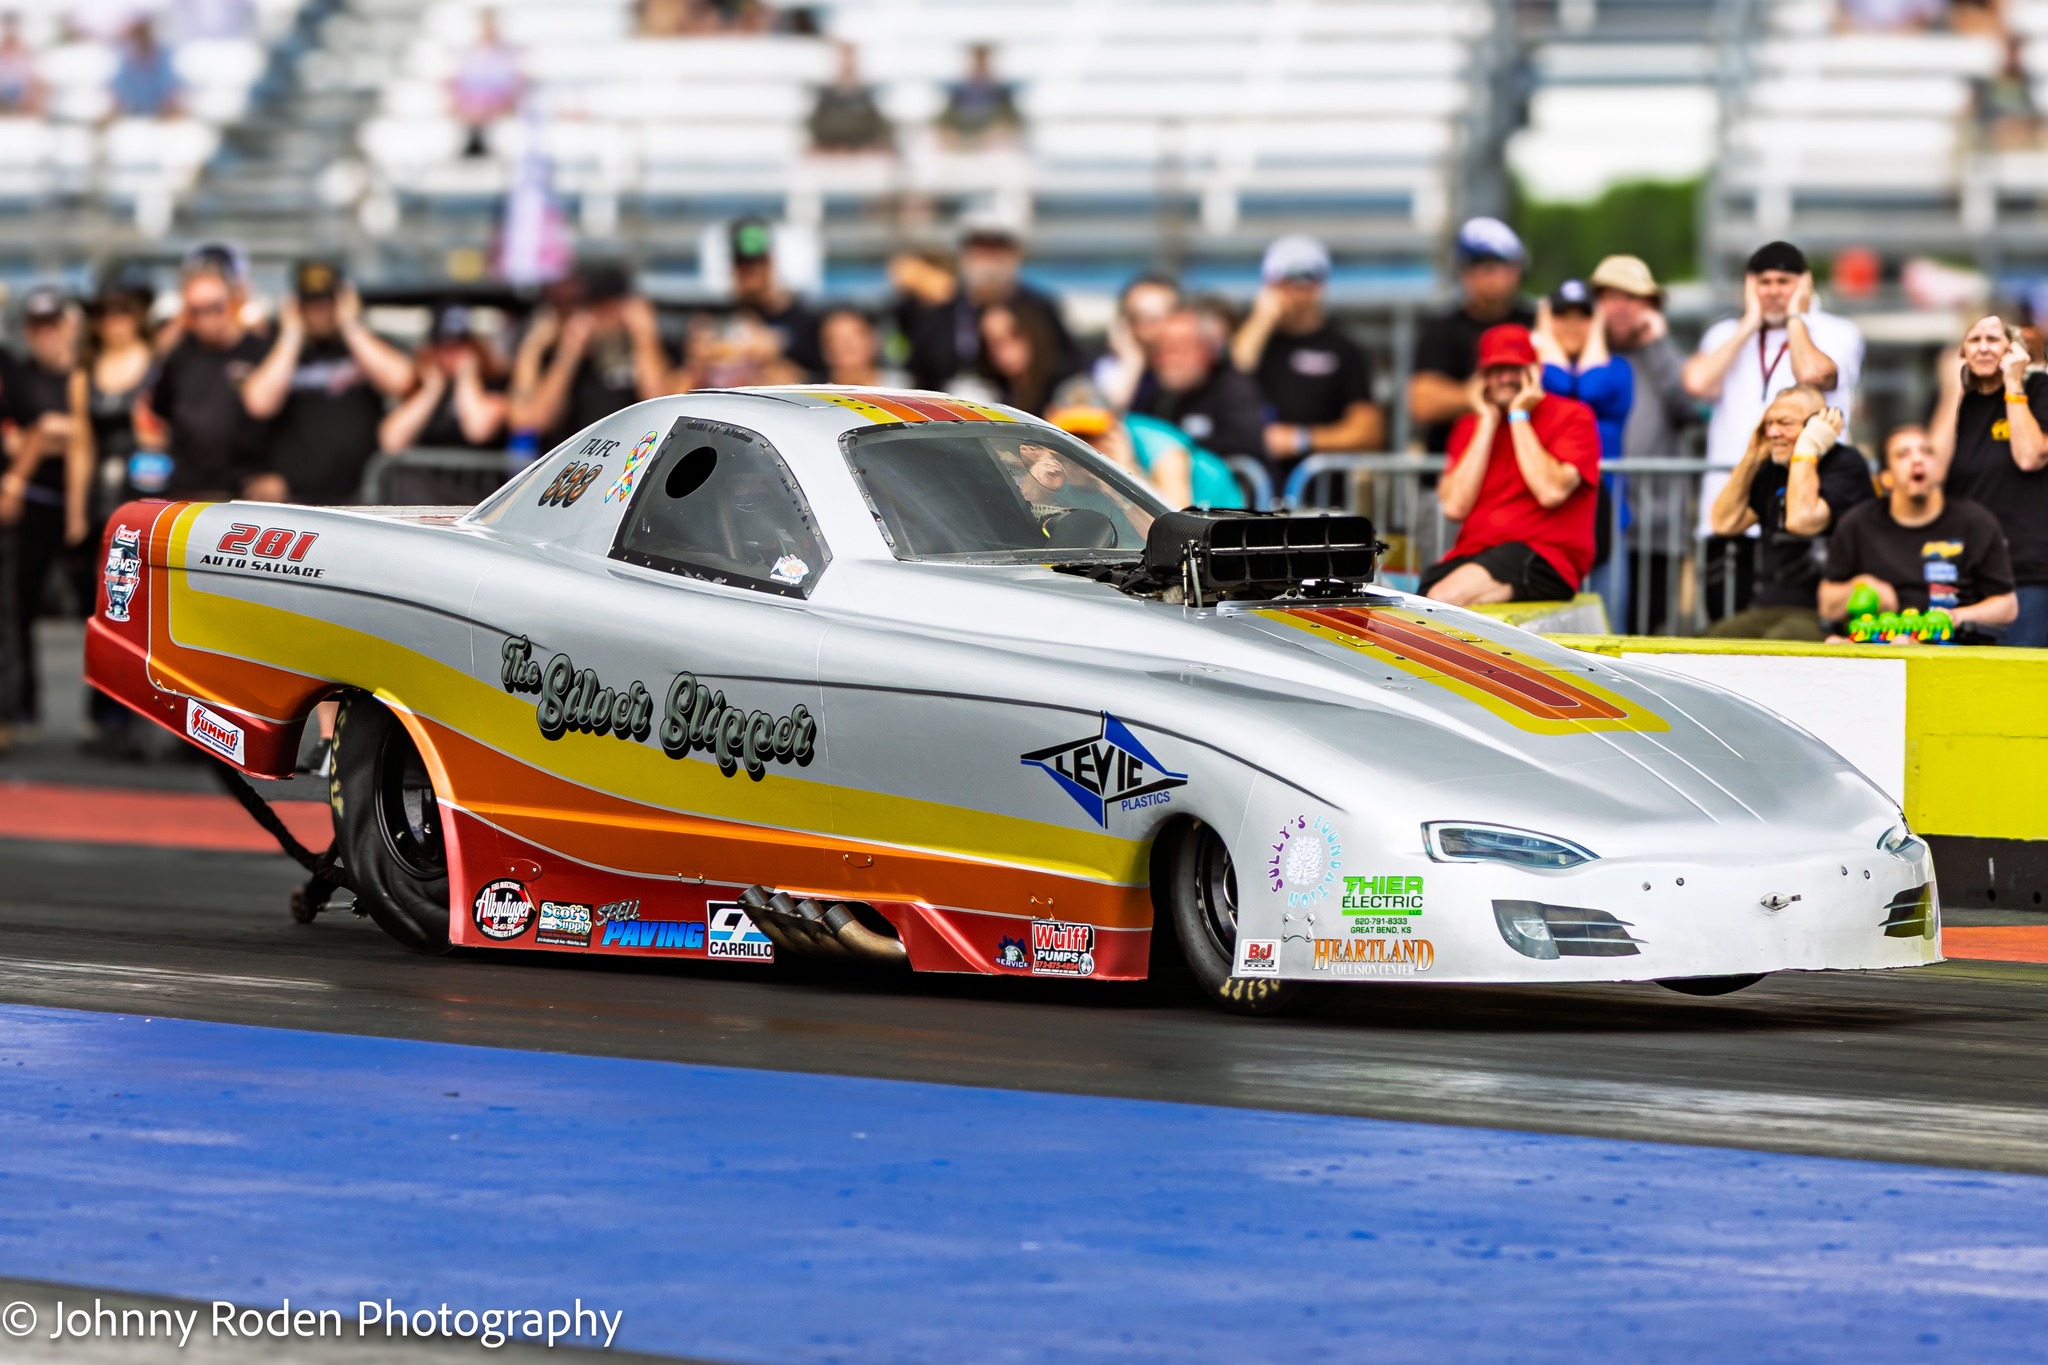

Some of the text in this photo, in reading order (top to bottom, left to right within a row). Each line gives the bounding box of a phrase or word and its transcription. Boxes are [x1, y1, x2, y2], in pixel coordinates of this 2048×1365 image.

[217, 523, 319, 562] 281
[200, 554, 326, 579] AUTO SALVAGE
[501, 634, 817, 782] The Silver Slipper
[1121, 791, 1170, 811] PLASTICS
[1343, 876, 1424, 896] THIER
[475, 888, 533, 924] Alkydigger
[1342, 895, 1423, 908] ELECTRIC
[542, 902, 589, 922] Scot's
[1354, 917, 1408, 925] 620-791-8333
[555, 918, 592, 934] Supply
[601, 920, 706, 949] PAVING
[1350, 926, 1412, 935] GREAT BEND, KS
[1034, 924, 1089, 952] Wulff
[709, 941, 773, 957] CARRILLO
[1037, 950, 1079, 962] PUMPS
[1312, 938, 1435, 971] HEARTLAND
[1331, 963, 1415, 977] COLLISION CENTER
